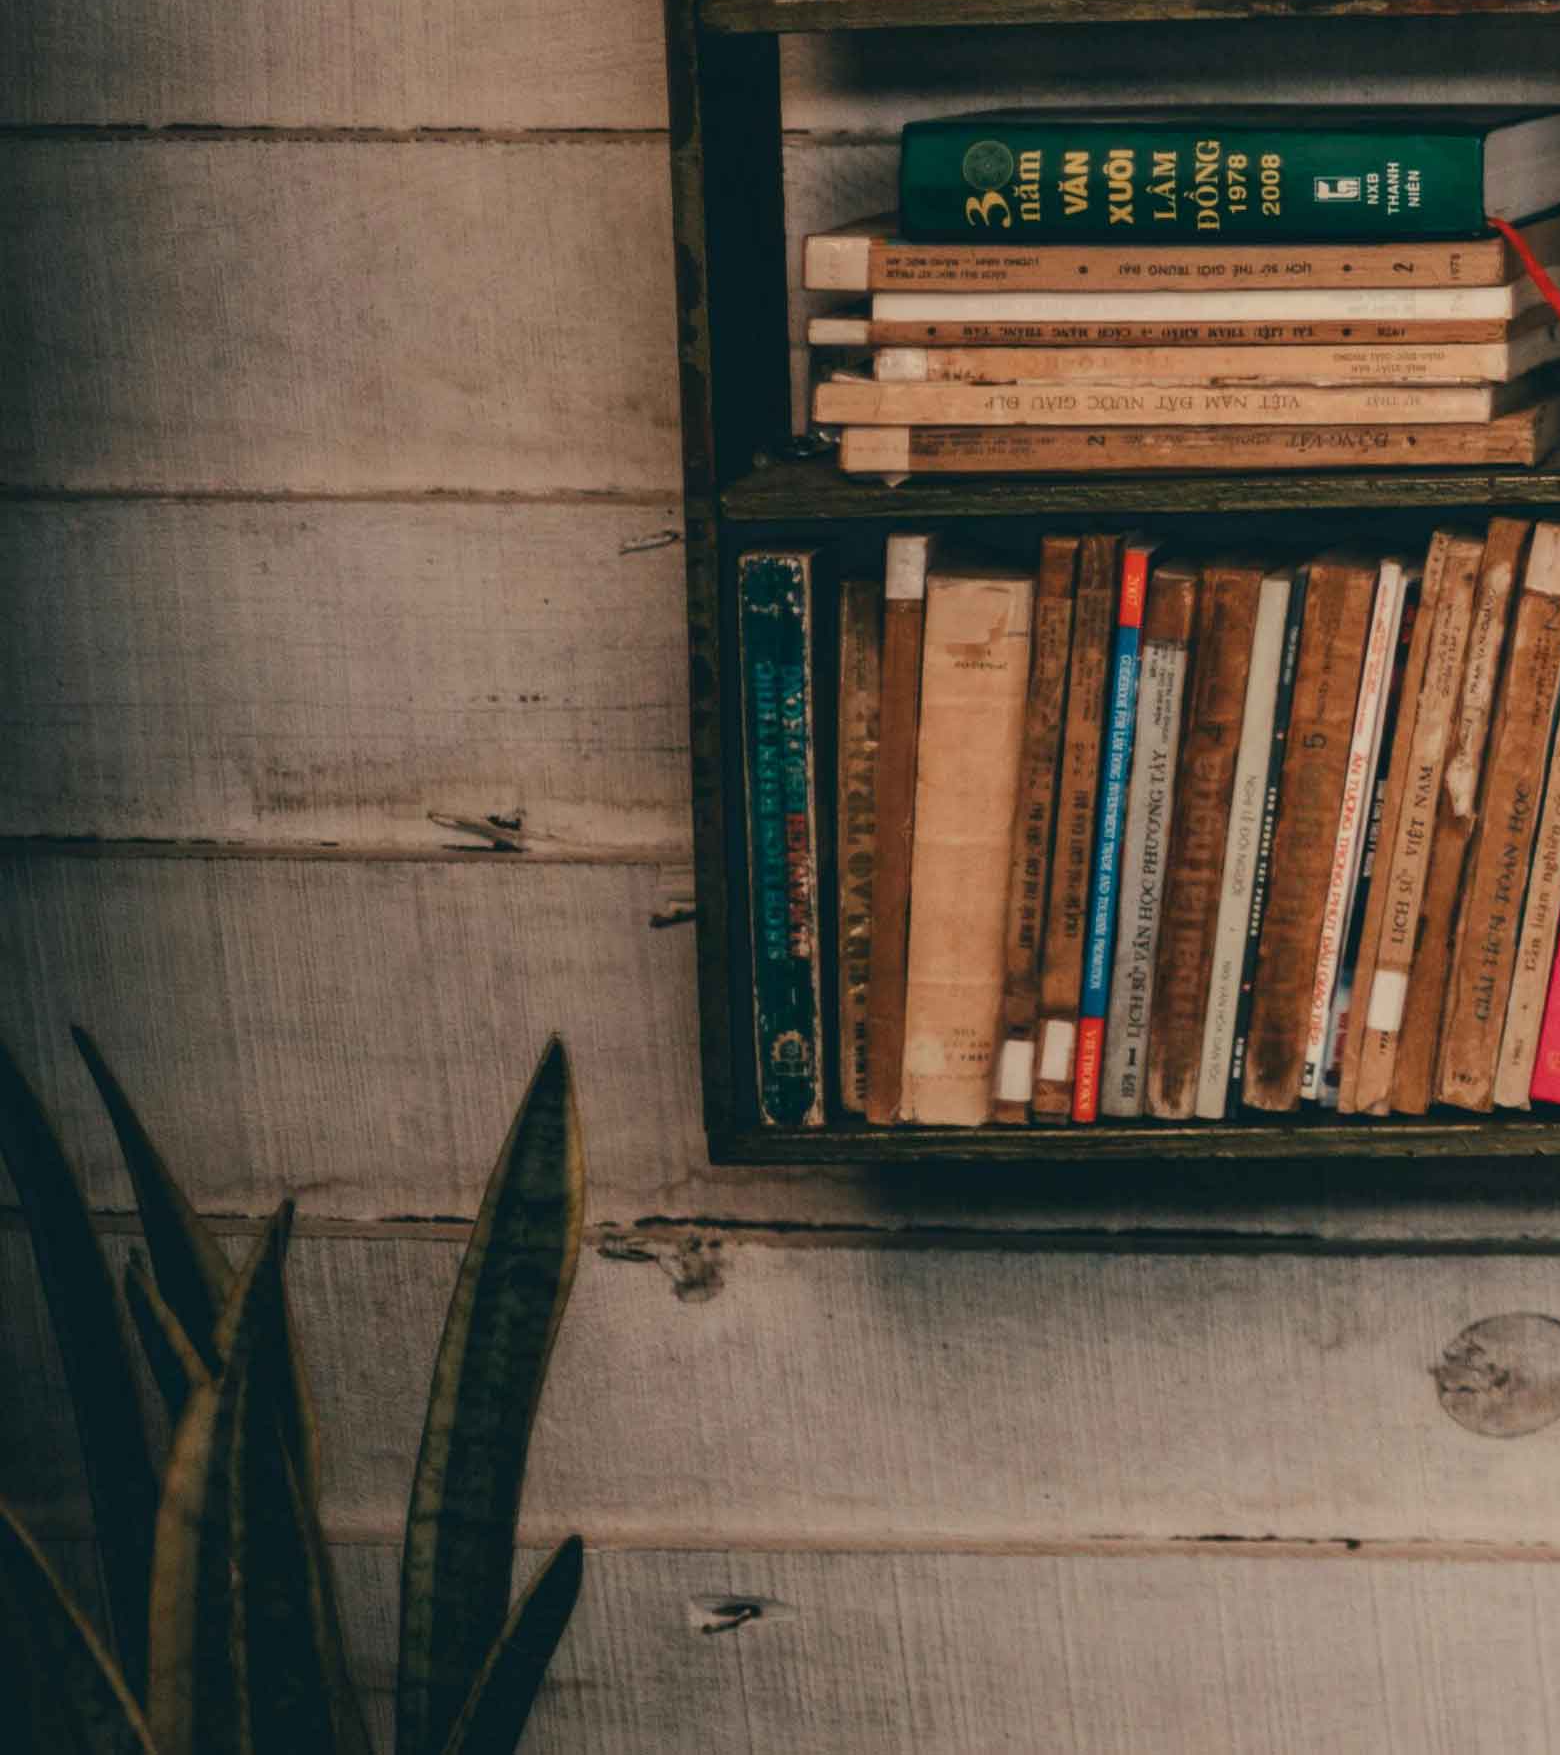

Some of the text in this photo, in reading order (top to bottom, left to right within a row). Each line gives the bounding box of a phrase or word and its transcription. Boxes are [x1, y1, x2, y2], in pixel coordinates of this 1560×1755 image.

[1018, 150, 1041, 222] năm
[1058, 151, 1090, 215] VĂN
[1103, 148, 1135, 223] XUÔI
[1146, 150, 1177, 222] LÂM
[1184, 139, 1221, 231] ĐỒNG
[1227, 153, 1249, 213] 1978
[1262, 153, 1281, 216] 2008
[1366, 172, 1380, 206] NXB
[1386, 161, 1400, 215] THANH
[1407, 169, 1420, 207] NIÊN
[1126, 748, 1169, 1039] LỊCH SỬ VĂN HỌC PHƯƠNG TÂY
